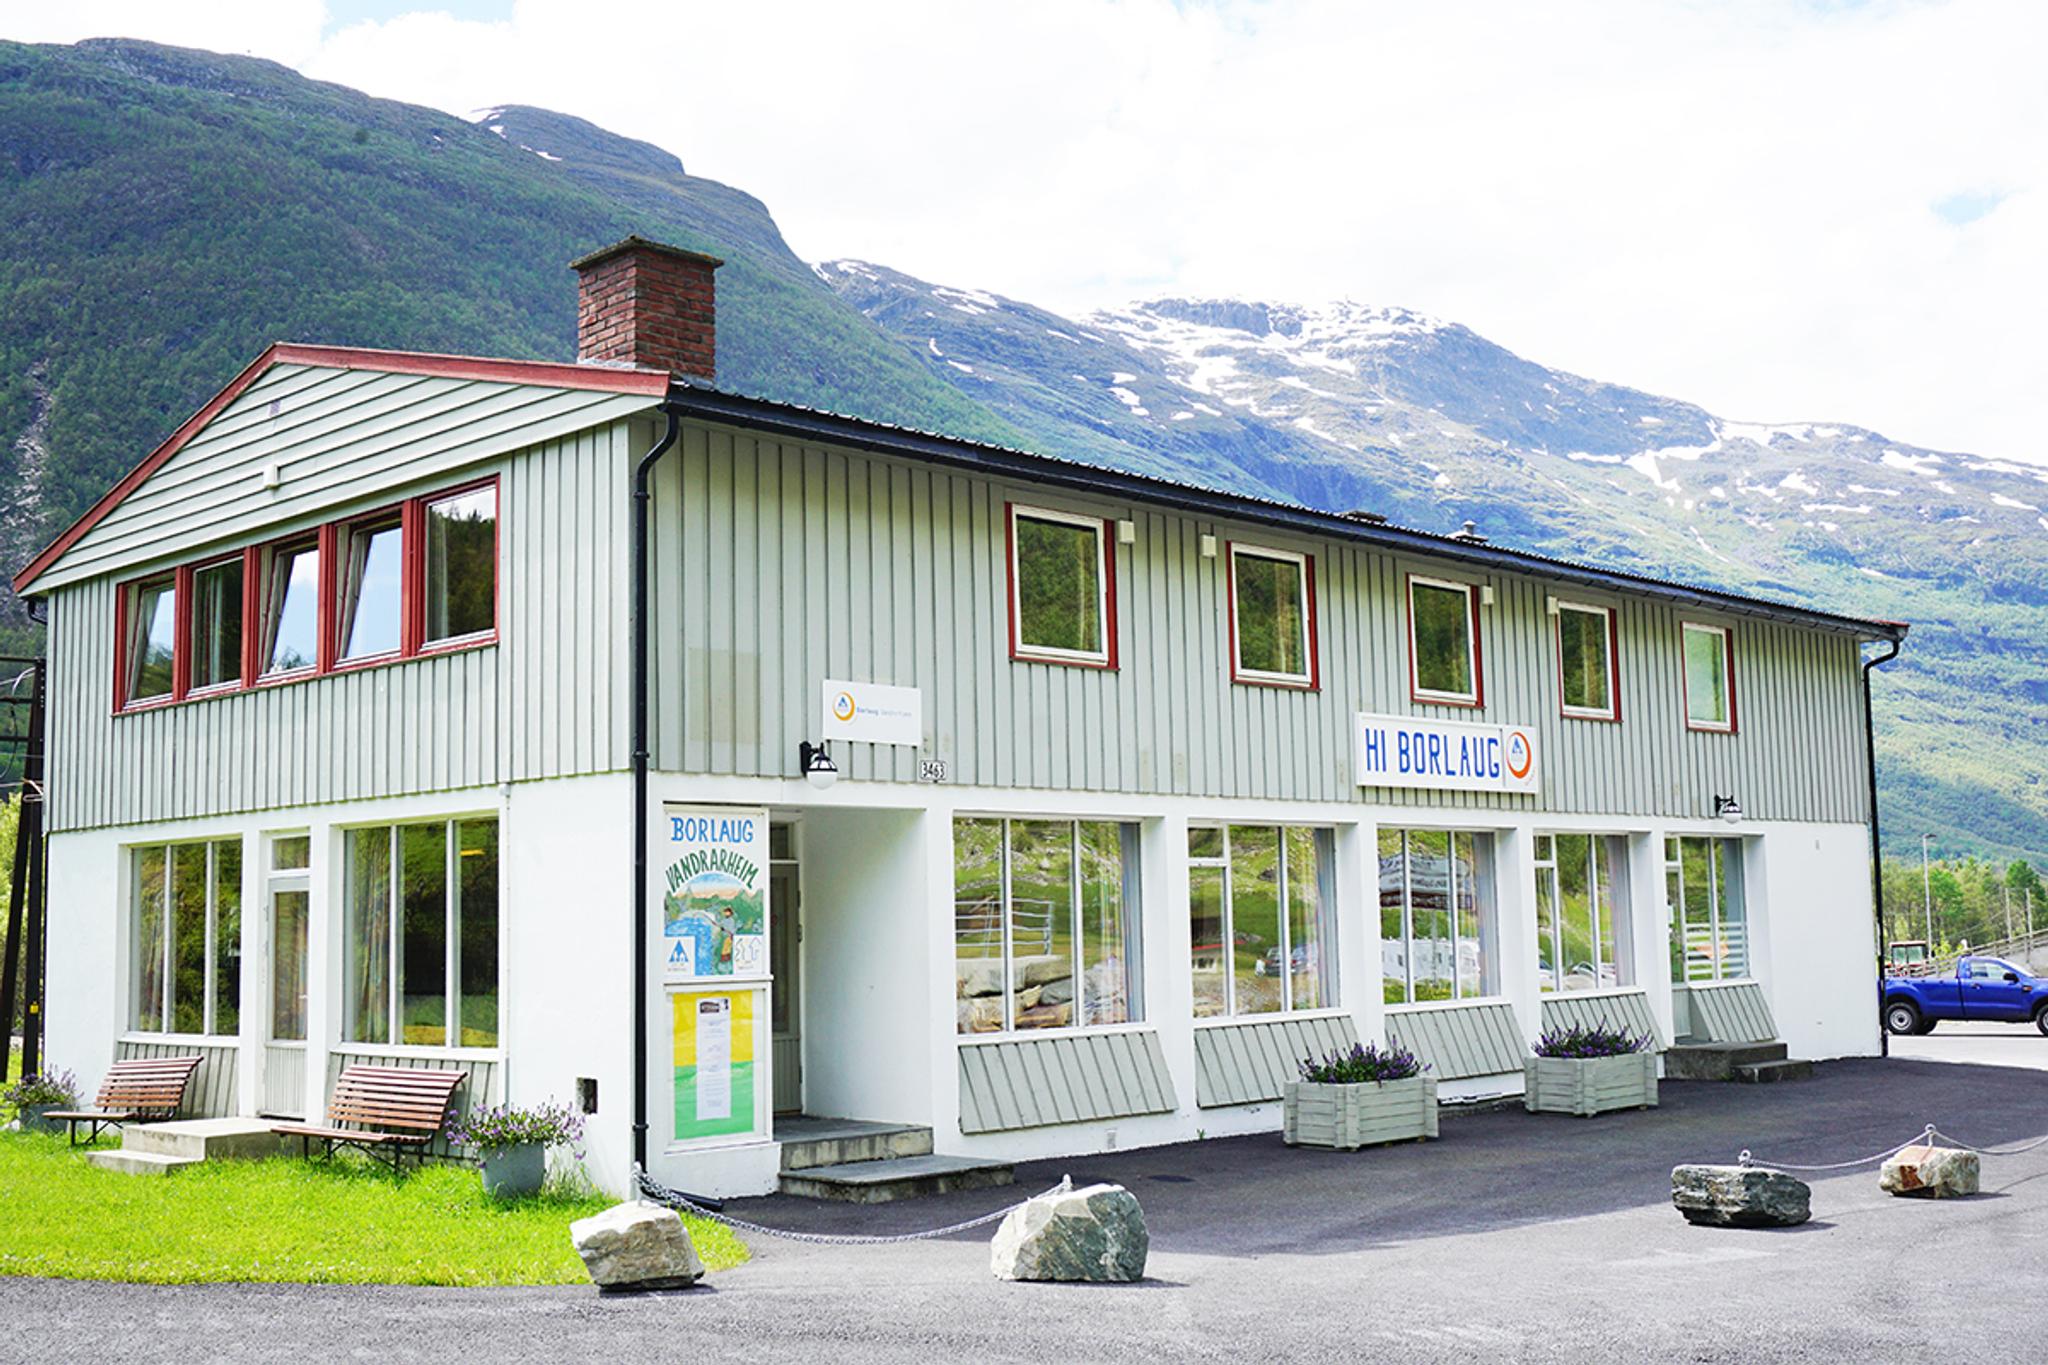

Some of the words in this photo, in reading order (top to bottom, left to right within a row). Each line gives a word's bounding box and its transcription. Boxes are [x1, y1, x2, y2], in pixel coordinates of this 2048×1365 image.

[923, 761, 945, 778] 3463
[1365, 728, 1387, 772] HI
[1398, 731, 1500, 778] BORLAUG
[671, 817, 753, 843] BORLAUG
[665, 849, 759, 892] VANDRARHEIM
